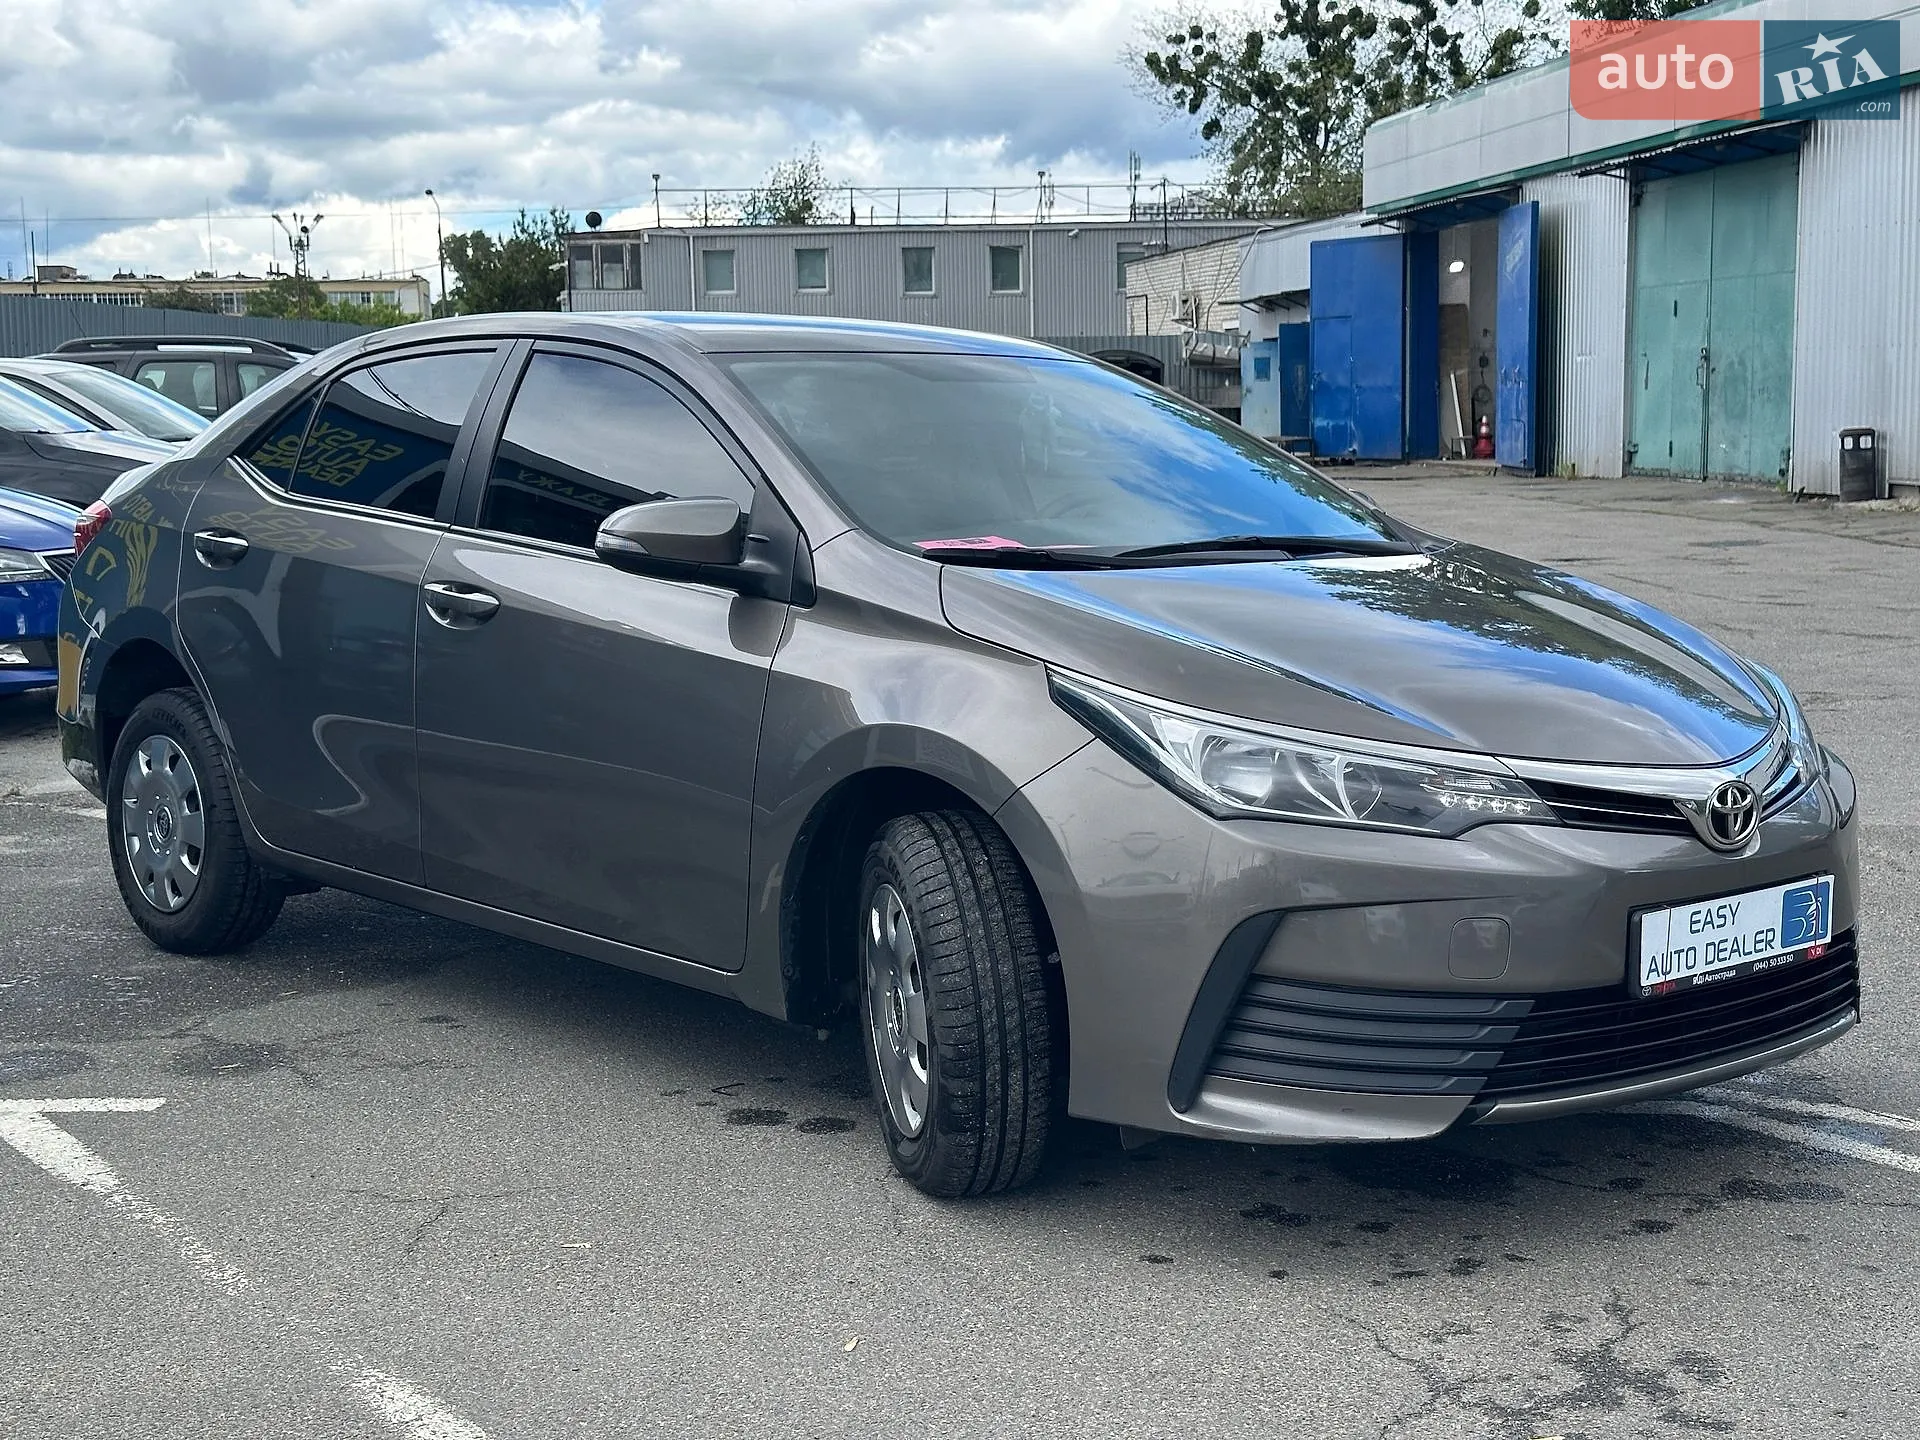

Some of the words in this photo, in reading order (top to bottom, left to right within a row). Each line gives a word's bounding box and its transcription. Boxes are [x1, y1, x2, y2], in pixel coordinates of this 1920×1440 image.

[1689, 901, 1741, 934] EASY
[1646, 945, 1697, 980] AUTO
[1705, 927, 1776, 966] DEALER
[1753, 960, 1769, 972] (044)
